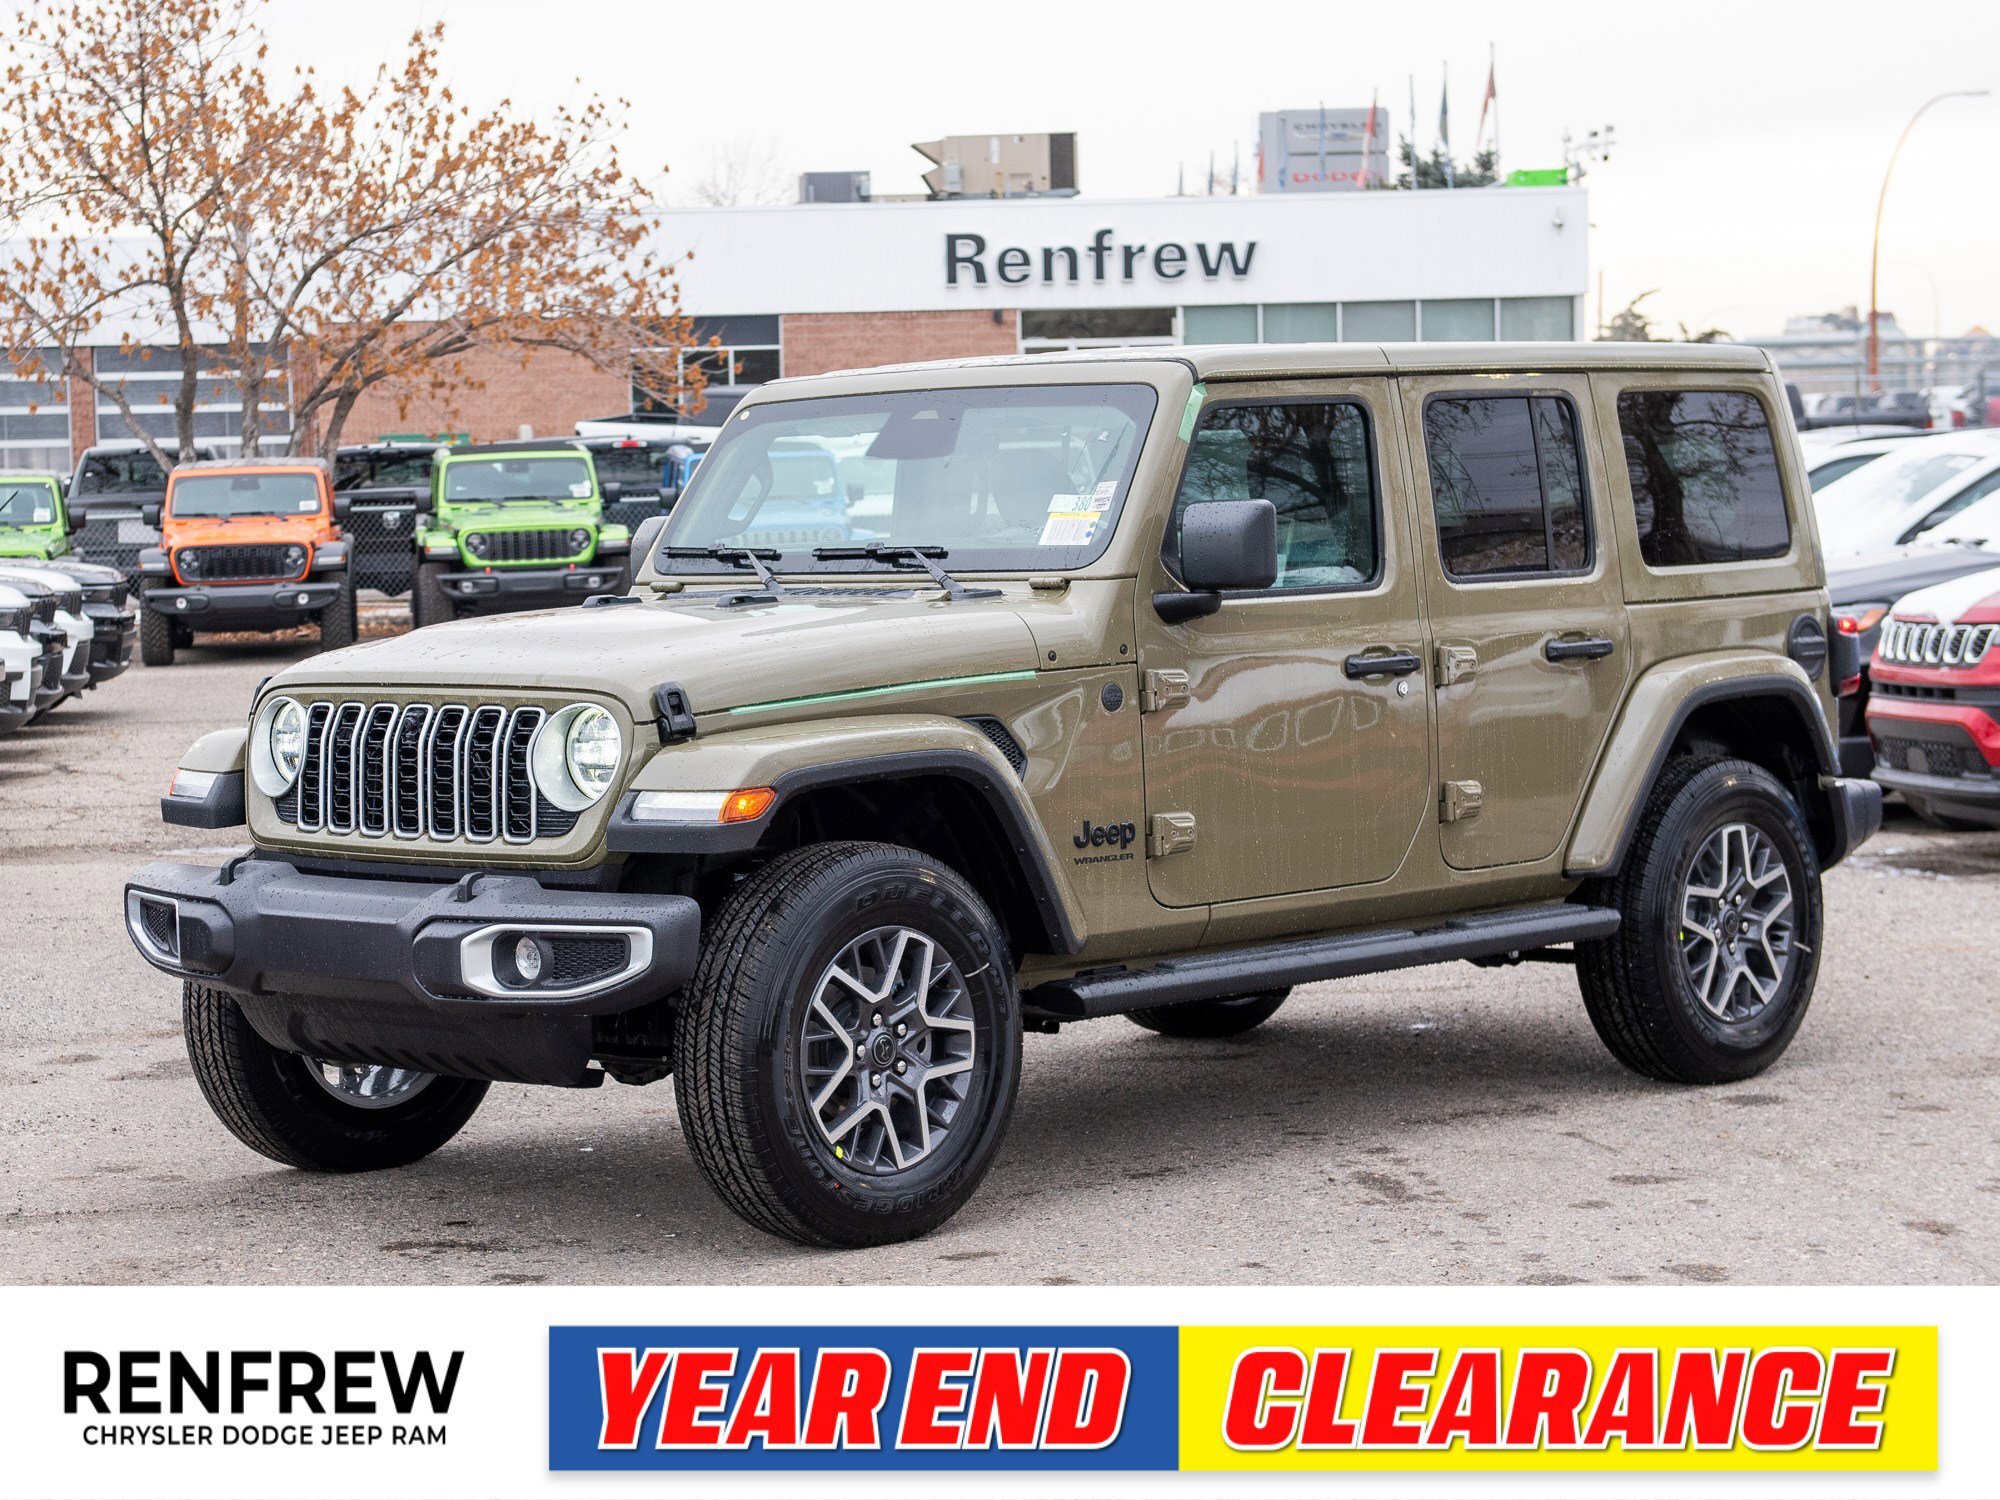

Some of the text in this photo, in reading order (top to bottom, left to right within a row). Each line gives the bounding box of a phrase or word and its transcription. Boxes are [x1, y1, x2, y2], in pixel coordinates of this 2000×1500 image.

[945, 229, 1256, 284] Renfrew
[1073, 820, 1136, 849] Jeep
[1075, 853, 1134, 865] WRANGLER
[854, 884, 992, 957] DUELER
[784, 1114, 966, 1214] BRIDGESTONE
